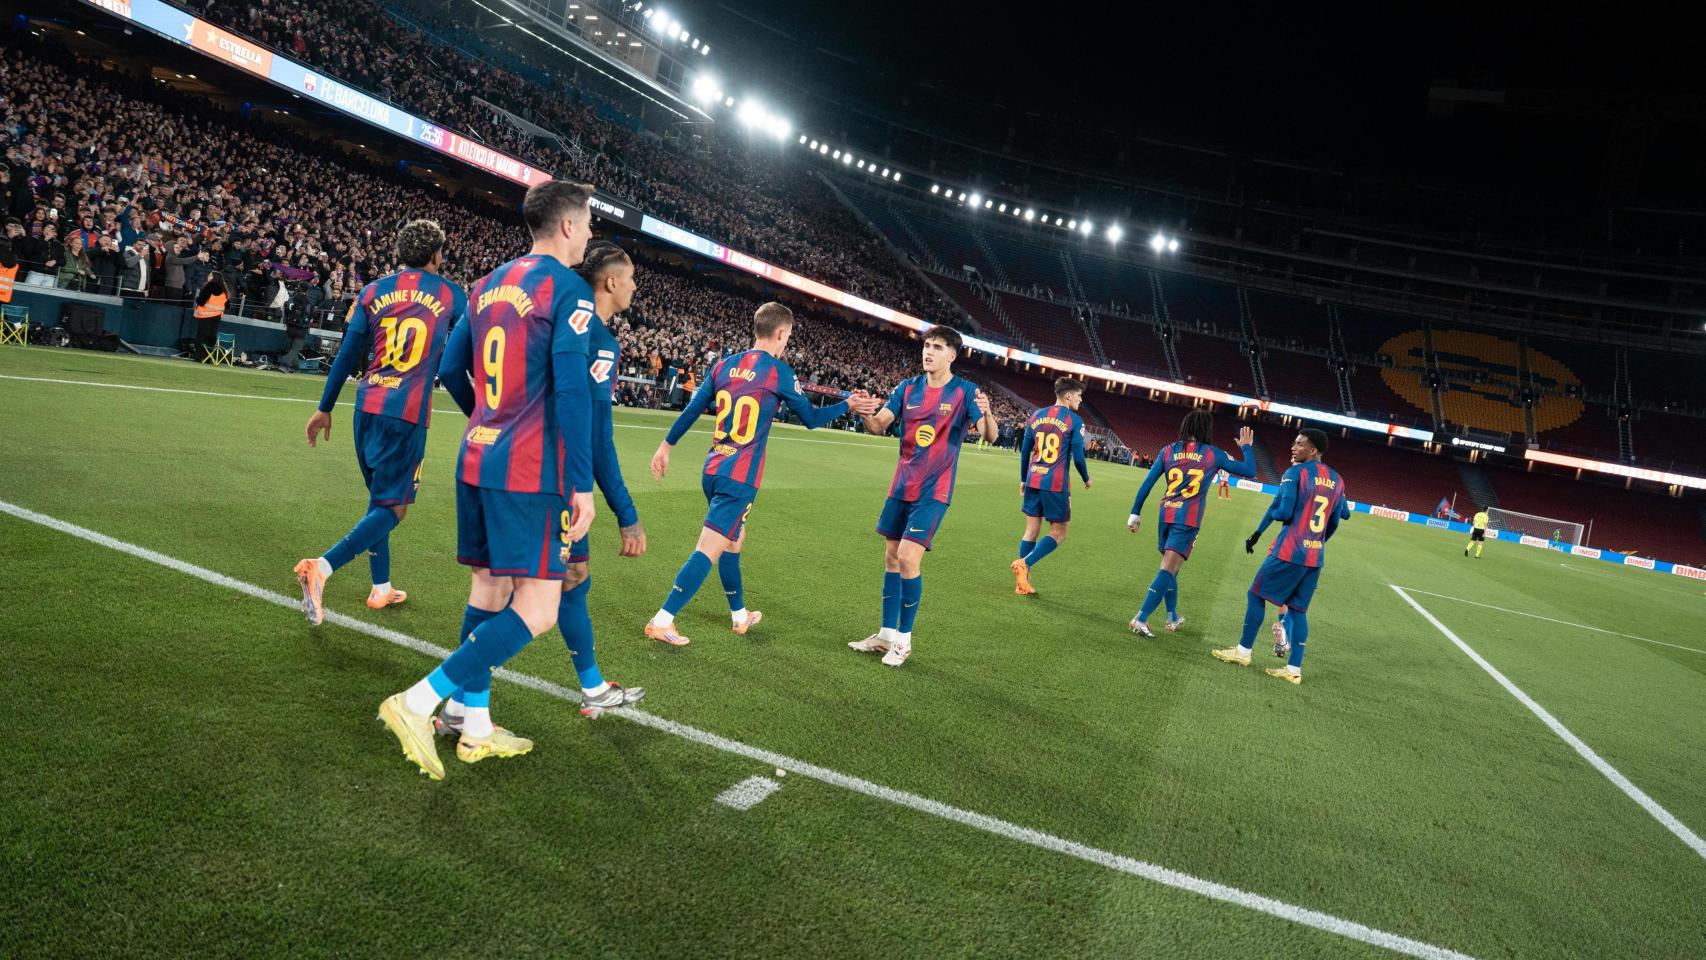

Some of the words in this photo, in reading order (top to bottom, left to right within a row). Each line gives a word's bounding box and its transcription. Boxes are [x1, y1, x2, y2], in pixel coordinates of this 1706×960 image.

[218, 38, 262, 65] ESTRELLA
[319, 80, 334, 99] FC
[334, 87, 390, 125] BARCELONA
[405, 116, 413, 136] 1
[486, 152, 497, 167] DE
[495, 155, 520, 178] MADRID
[369, 289, 408, 315] LAMINE
[410, 289, 446, 318] YAMAL
[379, 317, 428, 372] 10
[483, 326, 506, 410] 9
[729, 367, 757, 382] OLMO
[715, 389, 760, 445] 20
[1035, 431, 1060, 464] 18
[1173, 451, 1204, 463] KOUNDE
[1166, 467, 1205, 499] 23
[1314, 476, 1336, 490] BALDE
[1309, 494, 1329, 533] 3
[1372, 507, 1406, 521] BIMBO
[1573, 546, 1599, 558] BIMBO
[1626, 557, 1653, 568] BIMBO
